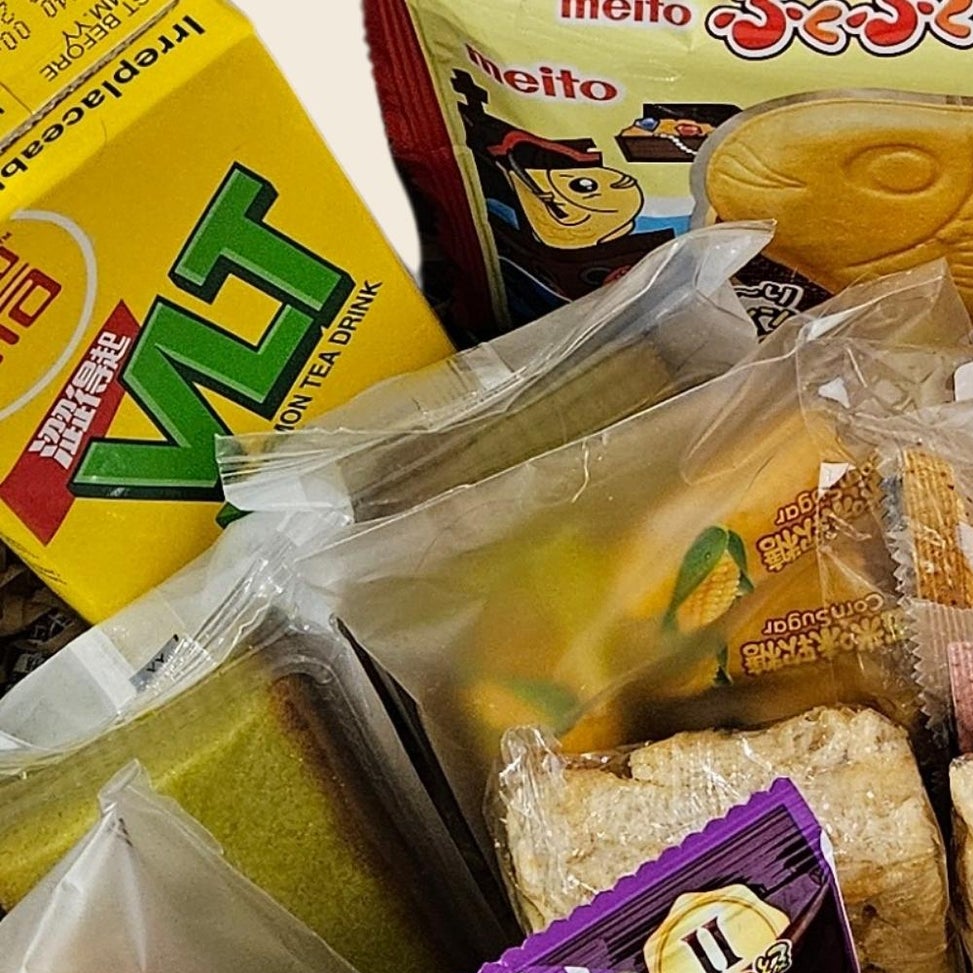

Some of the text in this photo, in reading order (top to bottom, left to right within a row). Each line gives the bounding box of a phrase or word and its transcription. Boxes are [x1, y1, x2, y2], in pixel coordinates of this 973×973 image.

[560, 0, 692, 26] meito
[39, 13, 122, 82] BEFORE
[464, 43, 618, 101] meito
[0, 15, 205, 190] Irreplaceab
[299, 350, 342, 388] TEA
[328, 279, 383, 346] DRINK
[761, 609, 830, 635] Sugar
